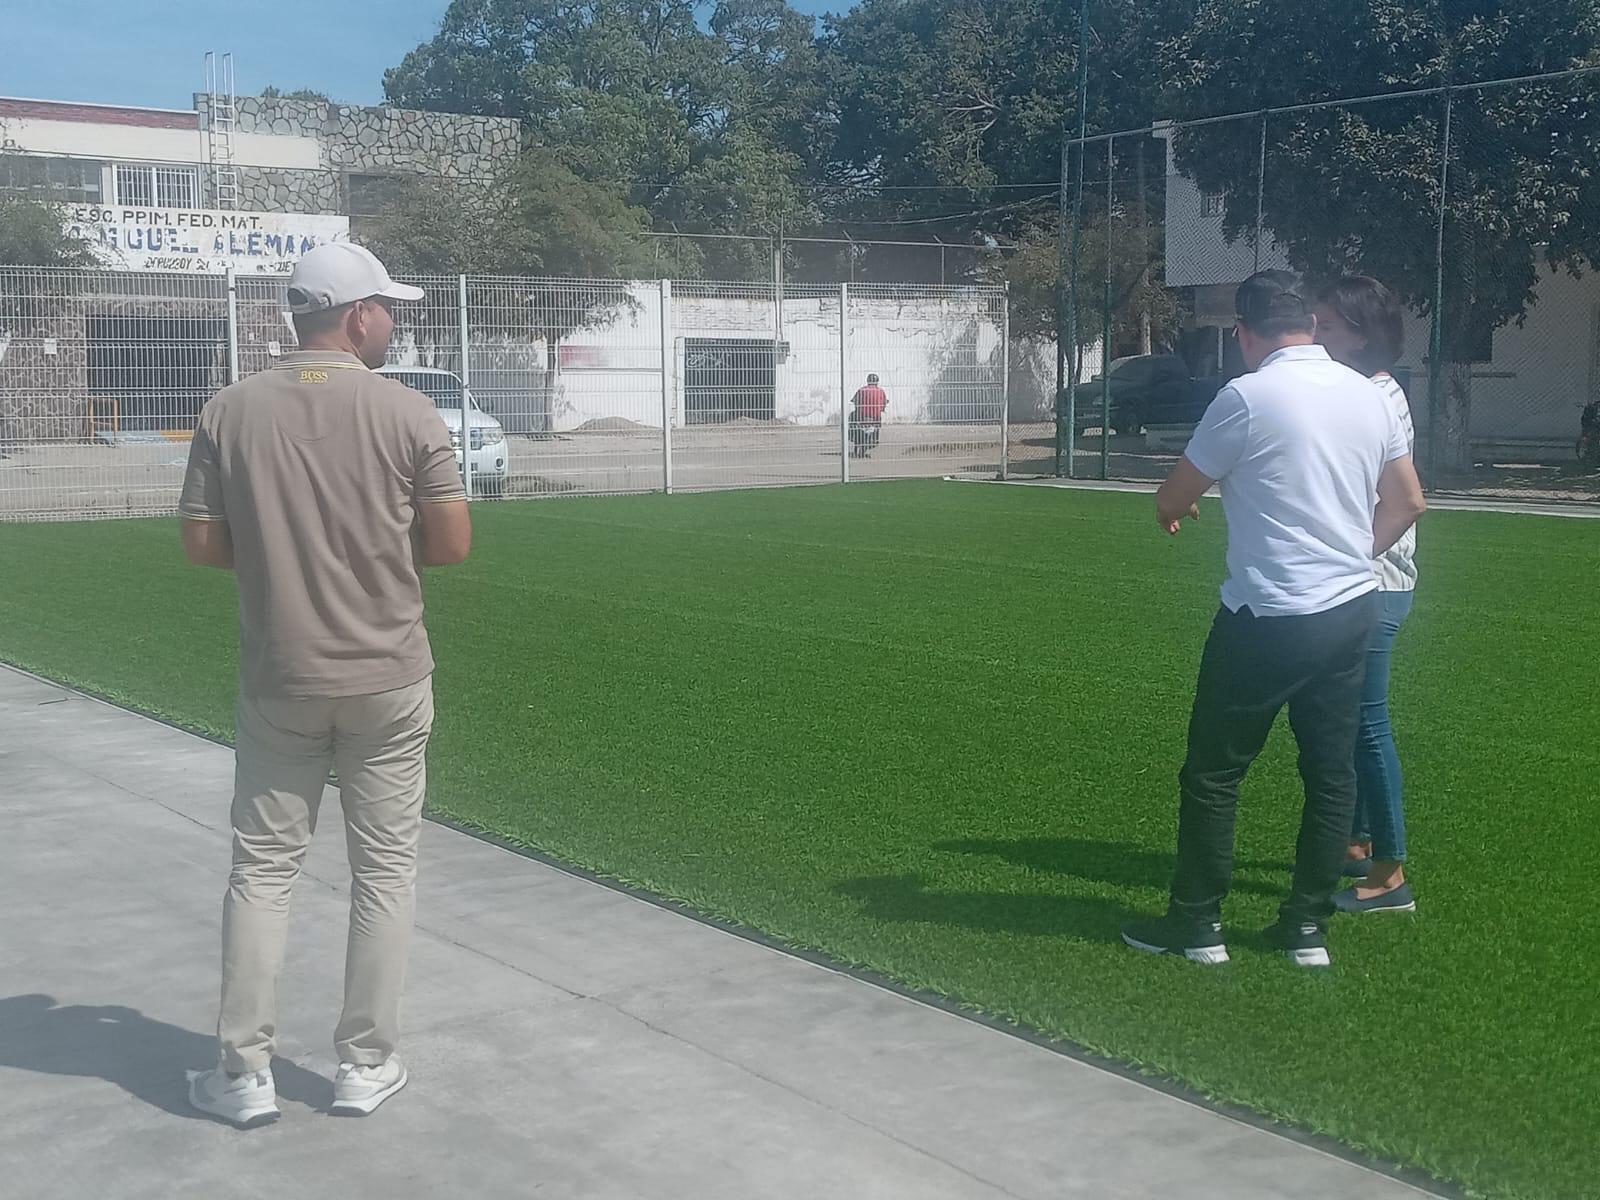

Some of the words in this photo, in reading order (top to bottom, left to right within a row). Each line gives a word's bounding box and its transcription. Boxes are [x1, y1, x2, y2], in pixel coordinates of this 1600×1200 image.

[178, 213, 216, 228] FED.
[221, 215, 264, 230] MAT.
[300, 370, 328, 380] BOSS
